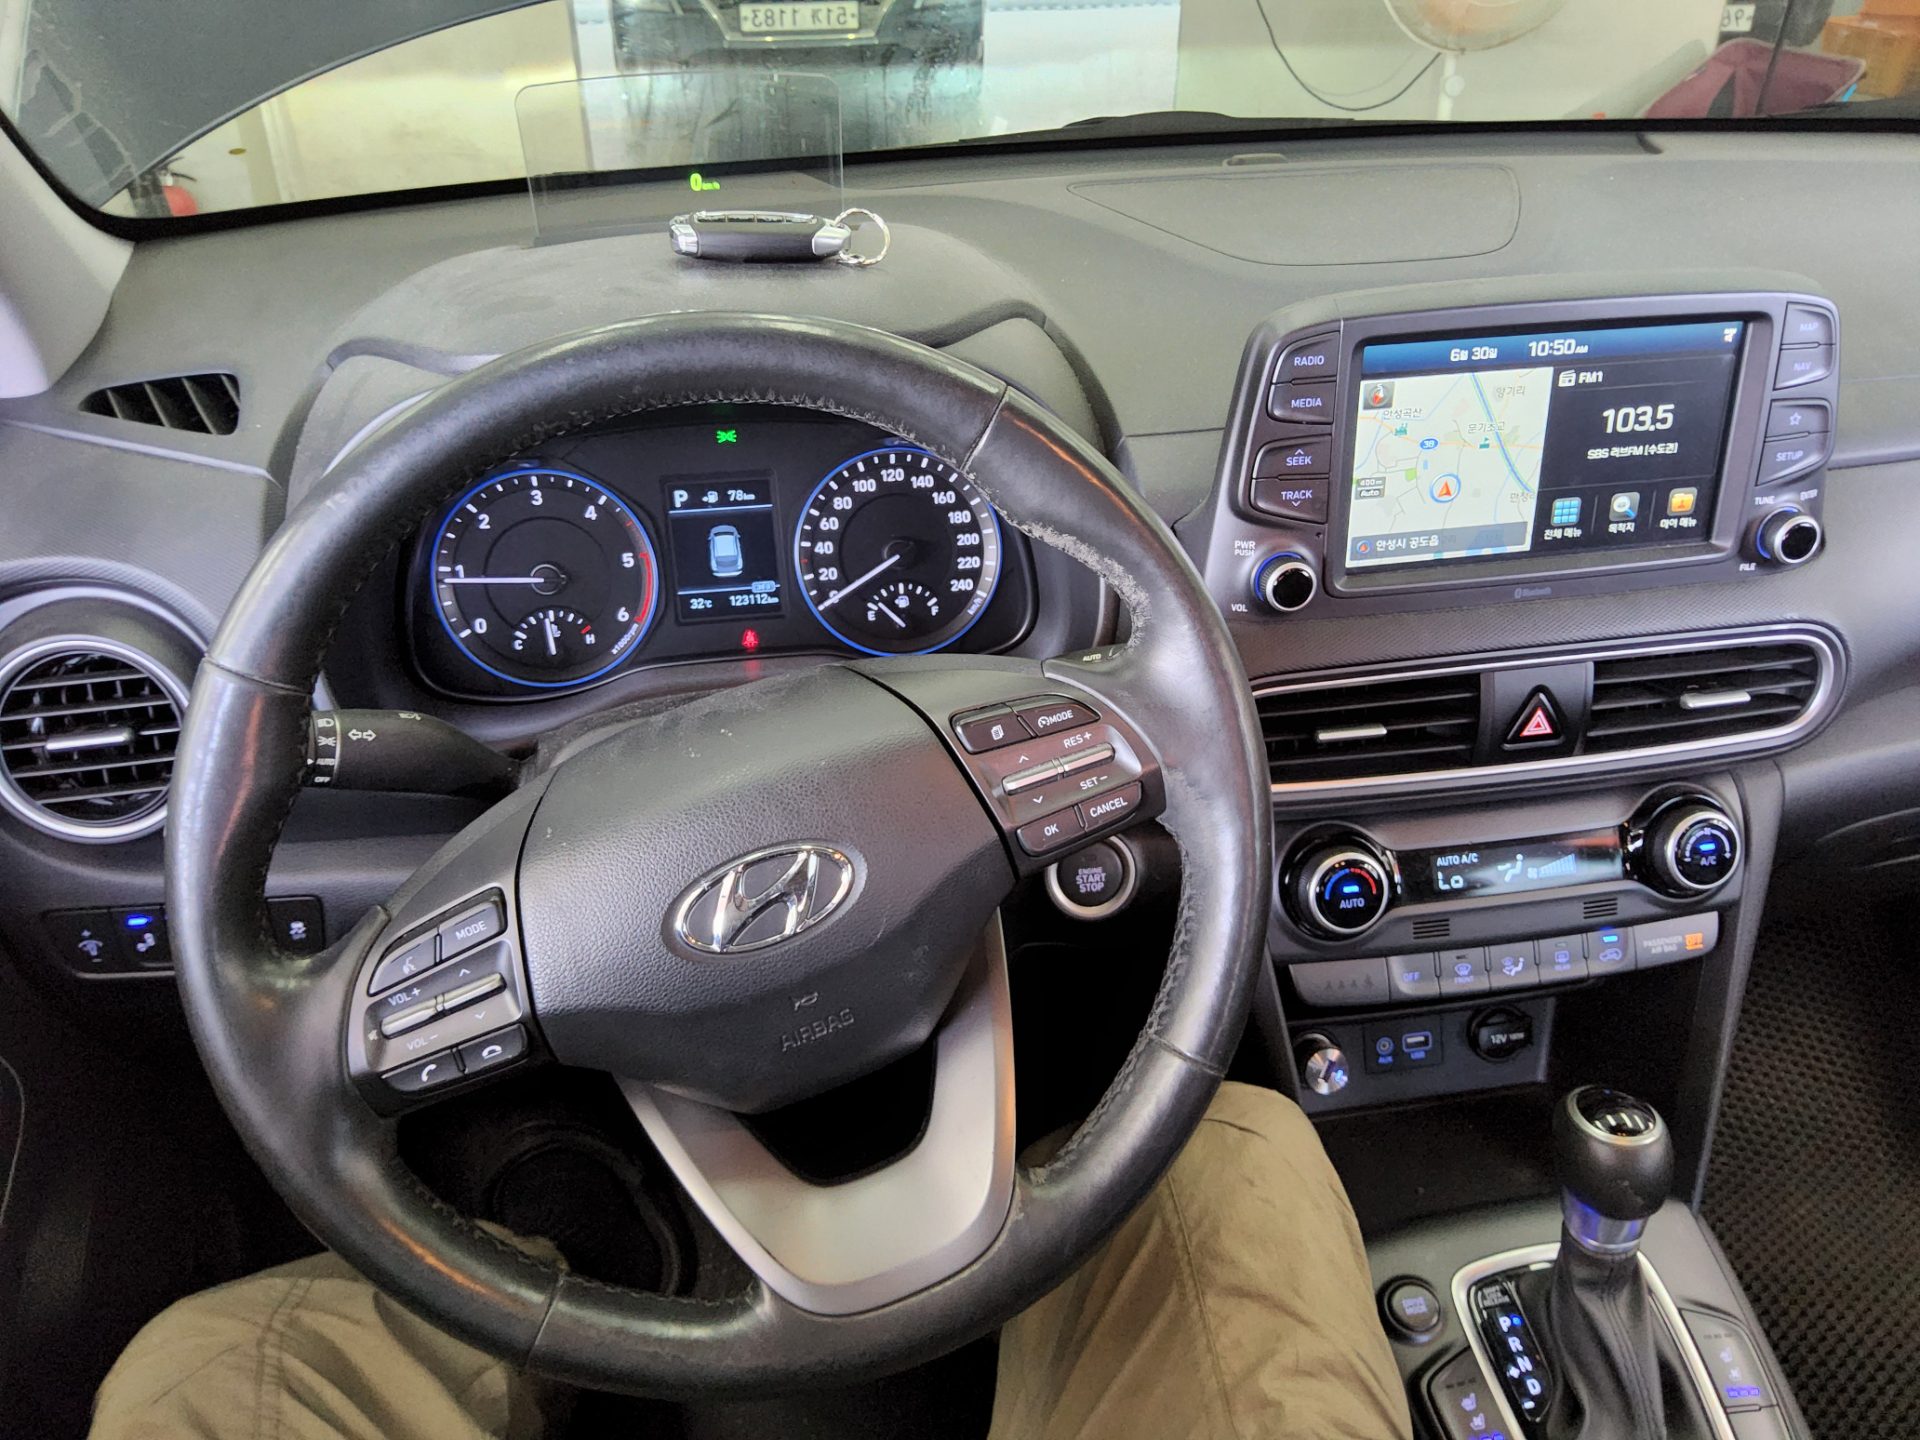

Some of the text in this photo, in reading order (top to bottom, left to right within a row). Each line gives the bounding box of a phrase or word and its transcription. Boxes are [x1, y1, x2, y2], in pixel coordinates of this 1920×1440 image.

[1294, 355, 1325, 366] RADIO
[1794, 361, 1812, 372] NAV
[1578, 371, 1603, 384] FM1
[1291, 397, 1322, 409] MEDIA
[1602, 403, 1676, 434] 103.5
[1286, 455, 1312, 466] SEEK
[1587, 448, 1609, 460] SBS
[1775, 451, 1804, 462] SETUP
[881, 468, 904, 482] 120
[910, 475, 935, 489] 140
[852, 478, 877, 492] 100
[530, 490, 543, 506] 3
[673, 489, 688, 508] P
[932, 490, 956, 505] 160
[1281, 490, 1313, 501] TRACK
[833, 496, 853, 510] 80
[584, 505, 598, 521] 4
[948, 510, 972, 524] 180
[478, 514, 491, 530] 2
[819, 517, 839, 531] 60
[956, 533, 980, 547] 200
[1234, 540, 1256, 550] PWR
[1376, 535, 1439, 551] 안성시 공도읍
[814, 541, 834, 555] 40
[1234, 549, 1255, 557] PUSH
[621, 552, 635, 568] 5
[957, 556, 980, 570] 220
[455, 564, 465, 580] 1
[818, 567, 838, 581] 20
[1739, 563, 1756, 572] FILE
[950, 578, 974, 592] 240
[931, 606, 939, 617] F
[1231, 603, 1248, 612] VOL
[617, 607, 629, 623] 6
[867, 610, 876, 621] E
[474, 618, 487, 634] 0
[513, 640, 524, 651] C
[585, 633, 595, 645] H
[1049, 709, 1074, 725] MODE
[1089, 796, 1128, 818] CANCEL
[1044, 824, 1060, 837] OK
[1437, 852, 1479, 866] AUTO A/C
[1700, 855, 1717, 866] A/C
[1076, 872, 1107, 885] START
[1079, 882, 1105, 893] STOP
[1340, 898, 1365, 909] AUTO
[455, 920, 487, 941] MODE
[1403, 972, 1420, 982] OFF
[782, 1008, 854, 1052] AIRBAG
[1491, 1034, 1507, 1044] 12V
[1499, 1316, 1511, 1332] P
[1508, 1336, 1523, 1352] R
[1517, 1355, 1533, 1372] N
[1526, 1378, 1541, 1395] D
